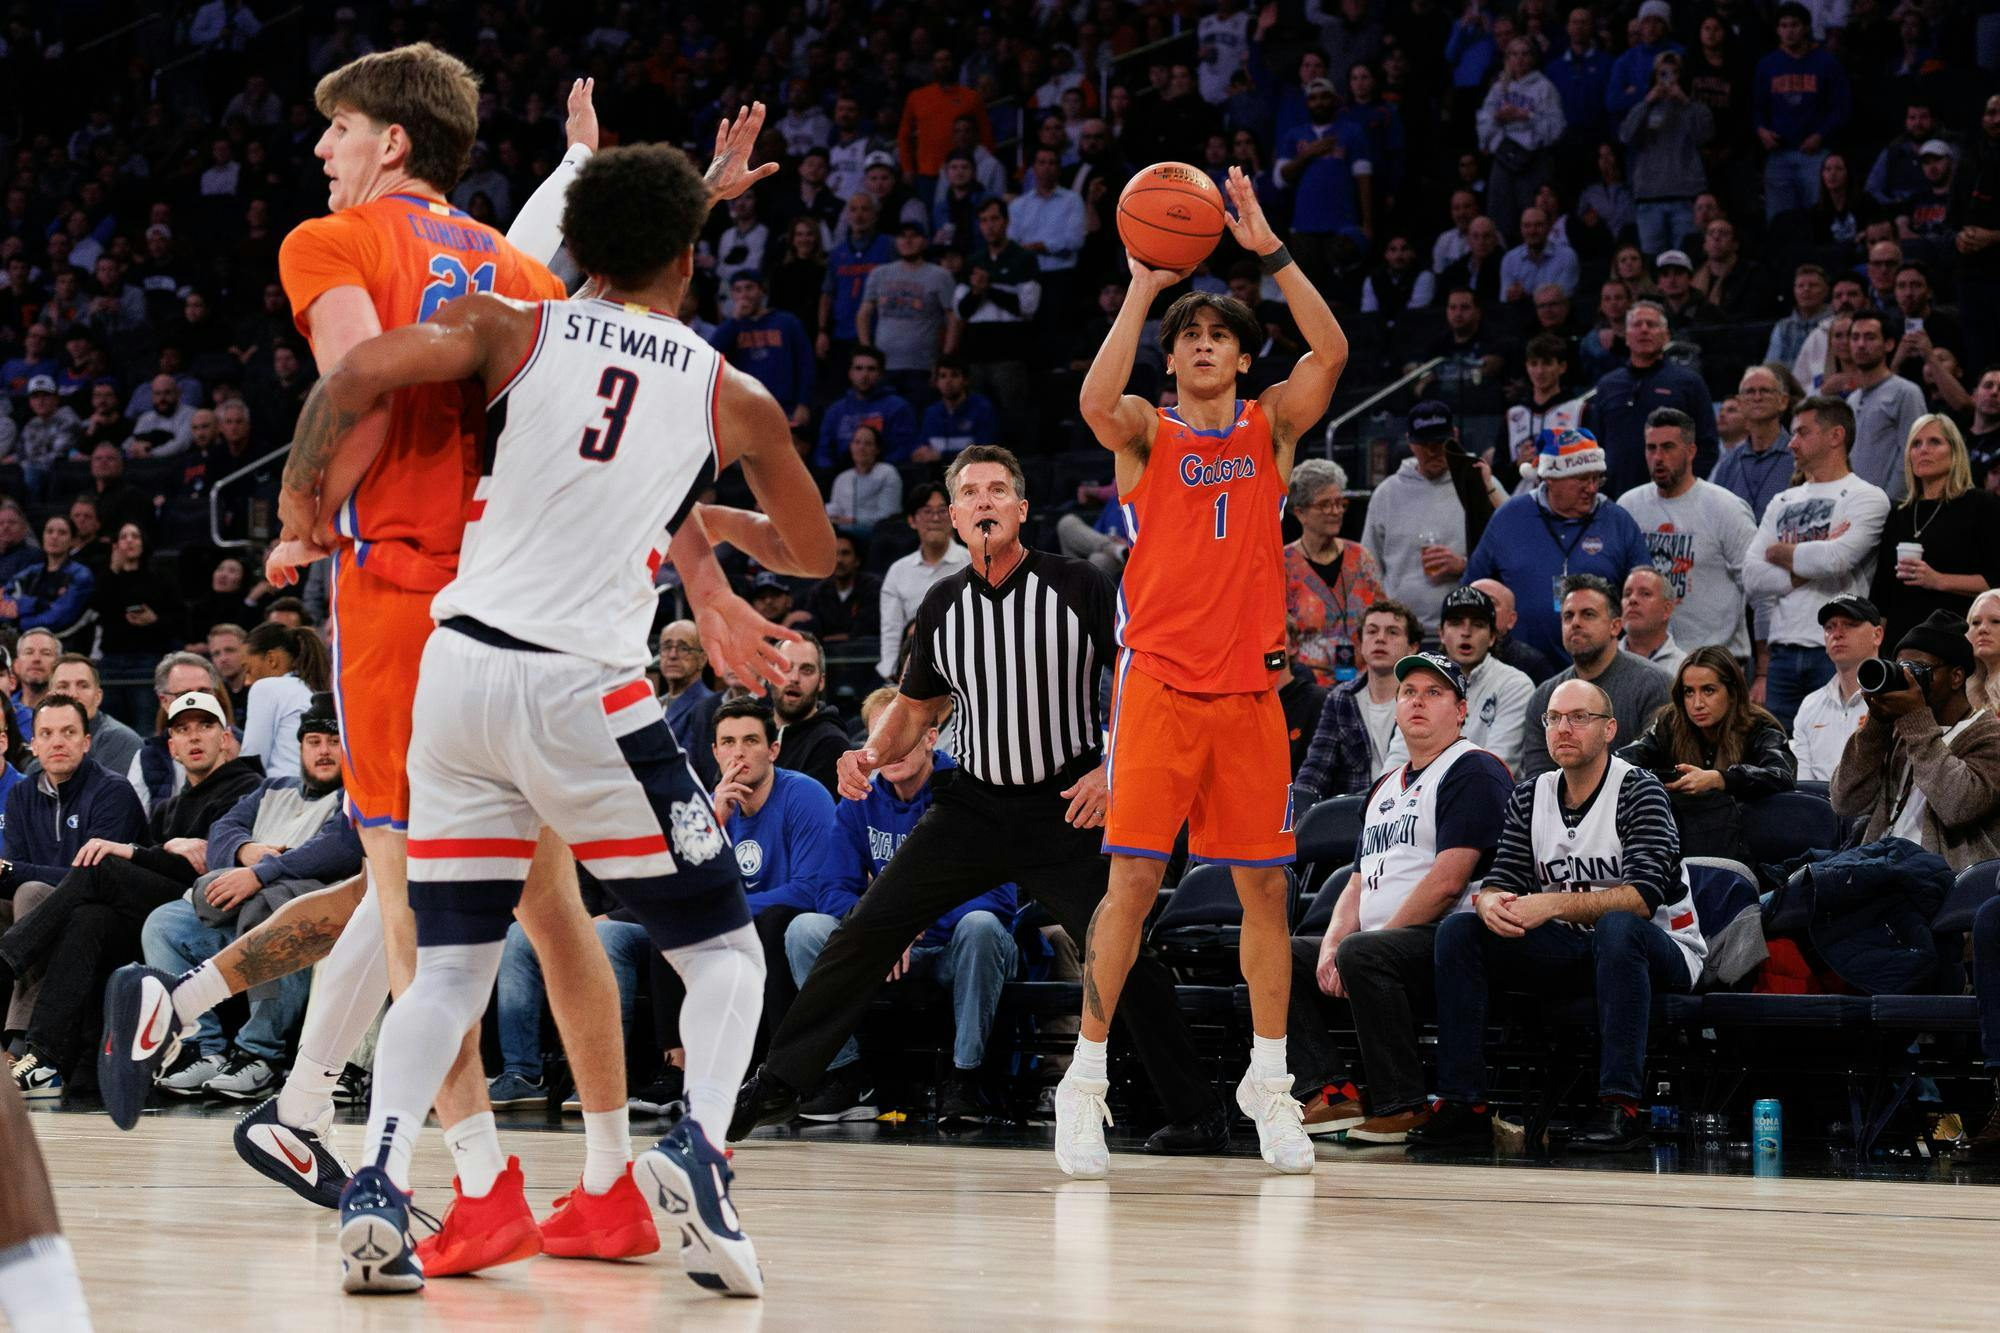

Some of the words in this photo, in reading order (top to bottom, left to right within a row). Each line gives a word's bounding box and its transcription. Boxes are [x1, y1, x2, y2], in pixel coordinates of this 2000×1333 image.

[564, 313, 697, 373] STEWART
[579, 365, 640, 463] 3
[1180, 453, 1256, 487] Gators
[1214, 491, 1228, 540] 1
[1361, 814, 1419, 857] CONNUT
